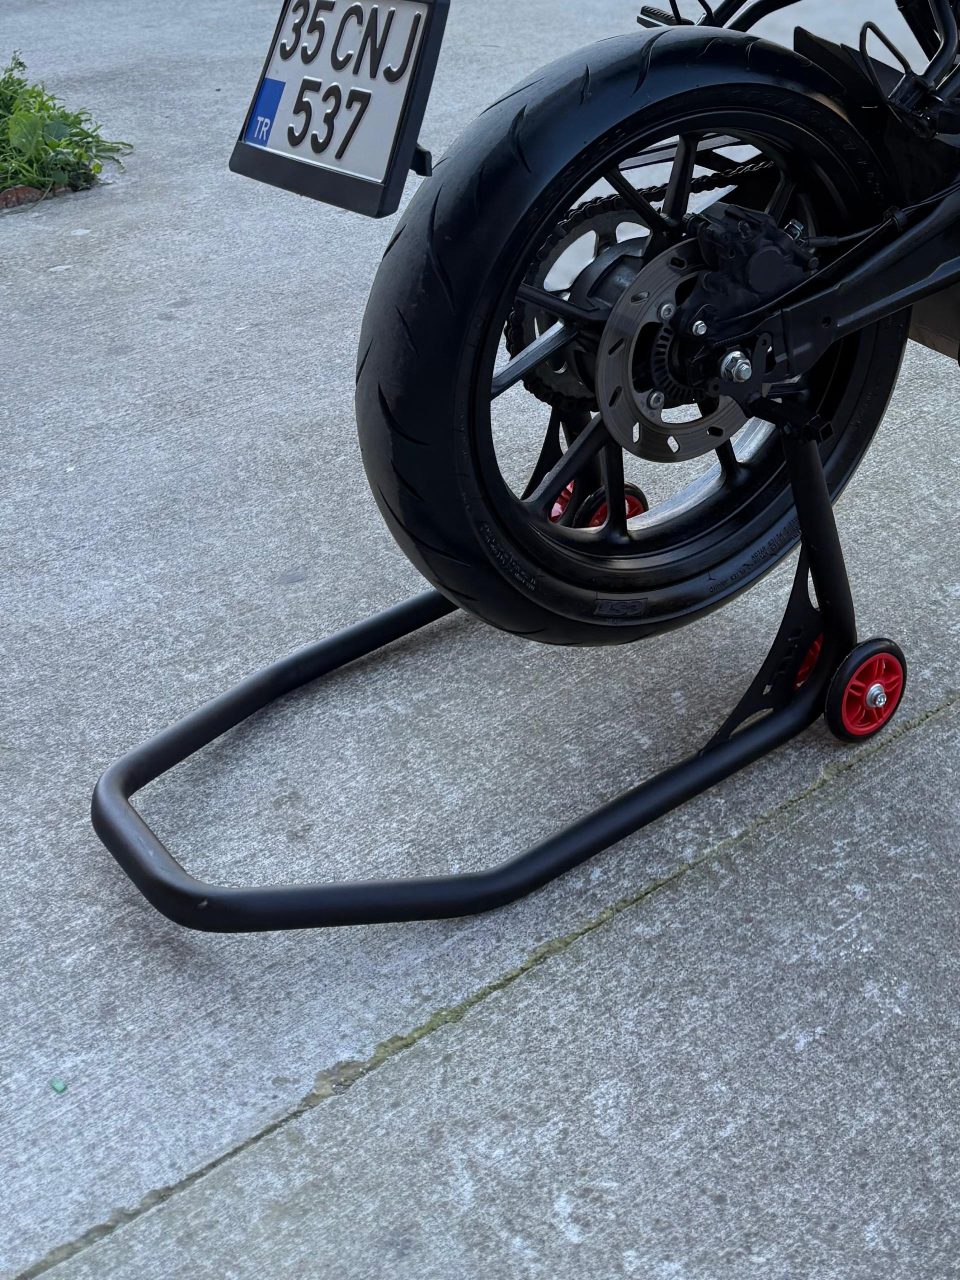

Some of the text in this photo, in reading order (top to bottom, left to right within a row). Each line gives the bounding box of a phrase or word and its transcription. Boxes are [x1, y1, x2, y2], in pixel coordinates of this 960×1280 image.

[330, 1, 422, 82] CNJ
[254, 116, 271, 140] TR
[287, 75, 372, 160] 537
